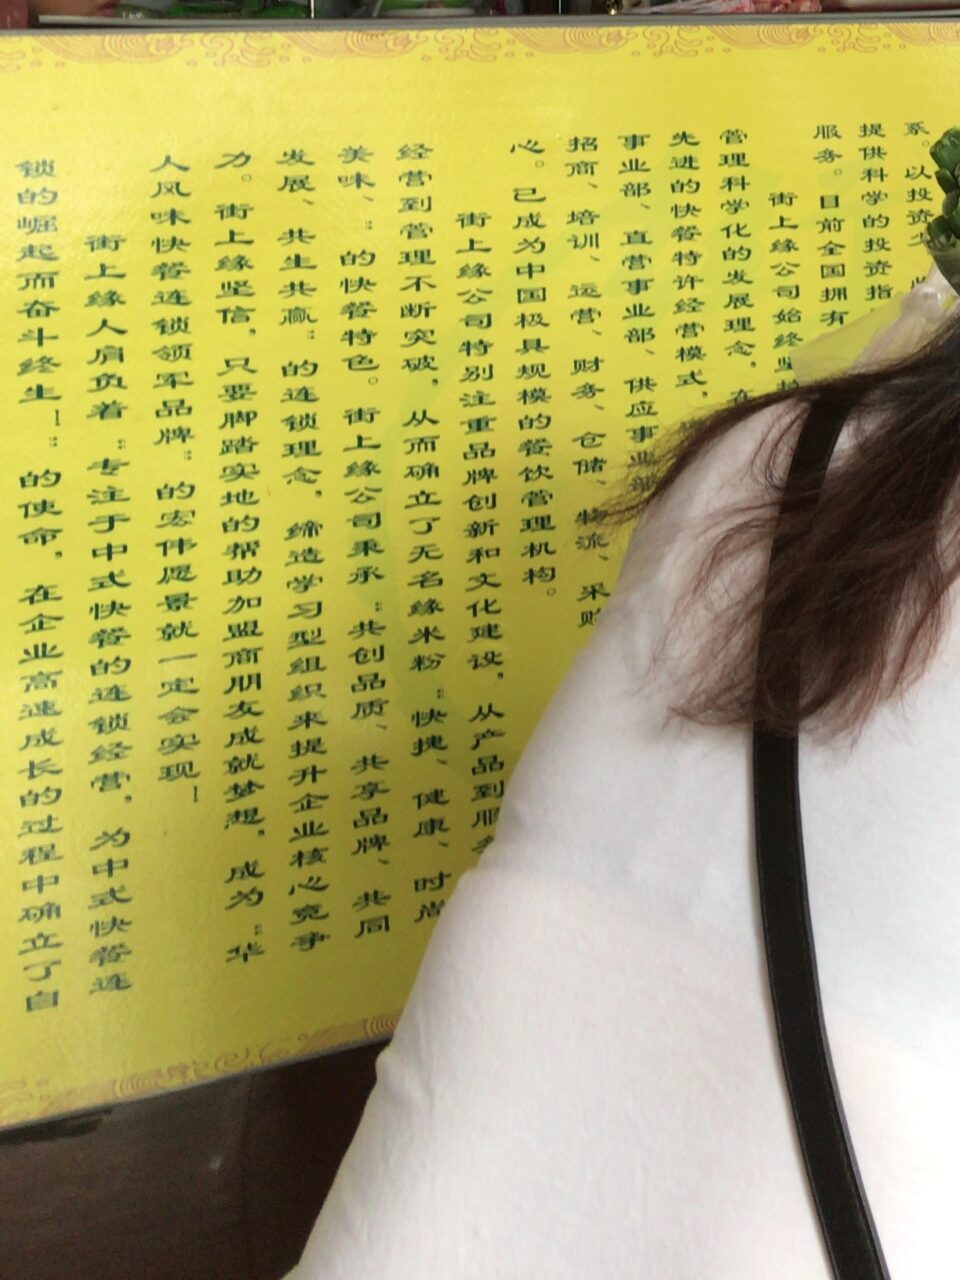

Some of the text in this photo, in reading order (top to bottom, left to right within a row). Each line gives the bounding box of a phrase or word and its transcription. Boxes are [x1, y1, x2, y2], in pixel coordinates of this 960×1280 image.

[859, 122, 893, 301] 提供科学的投资指
